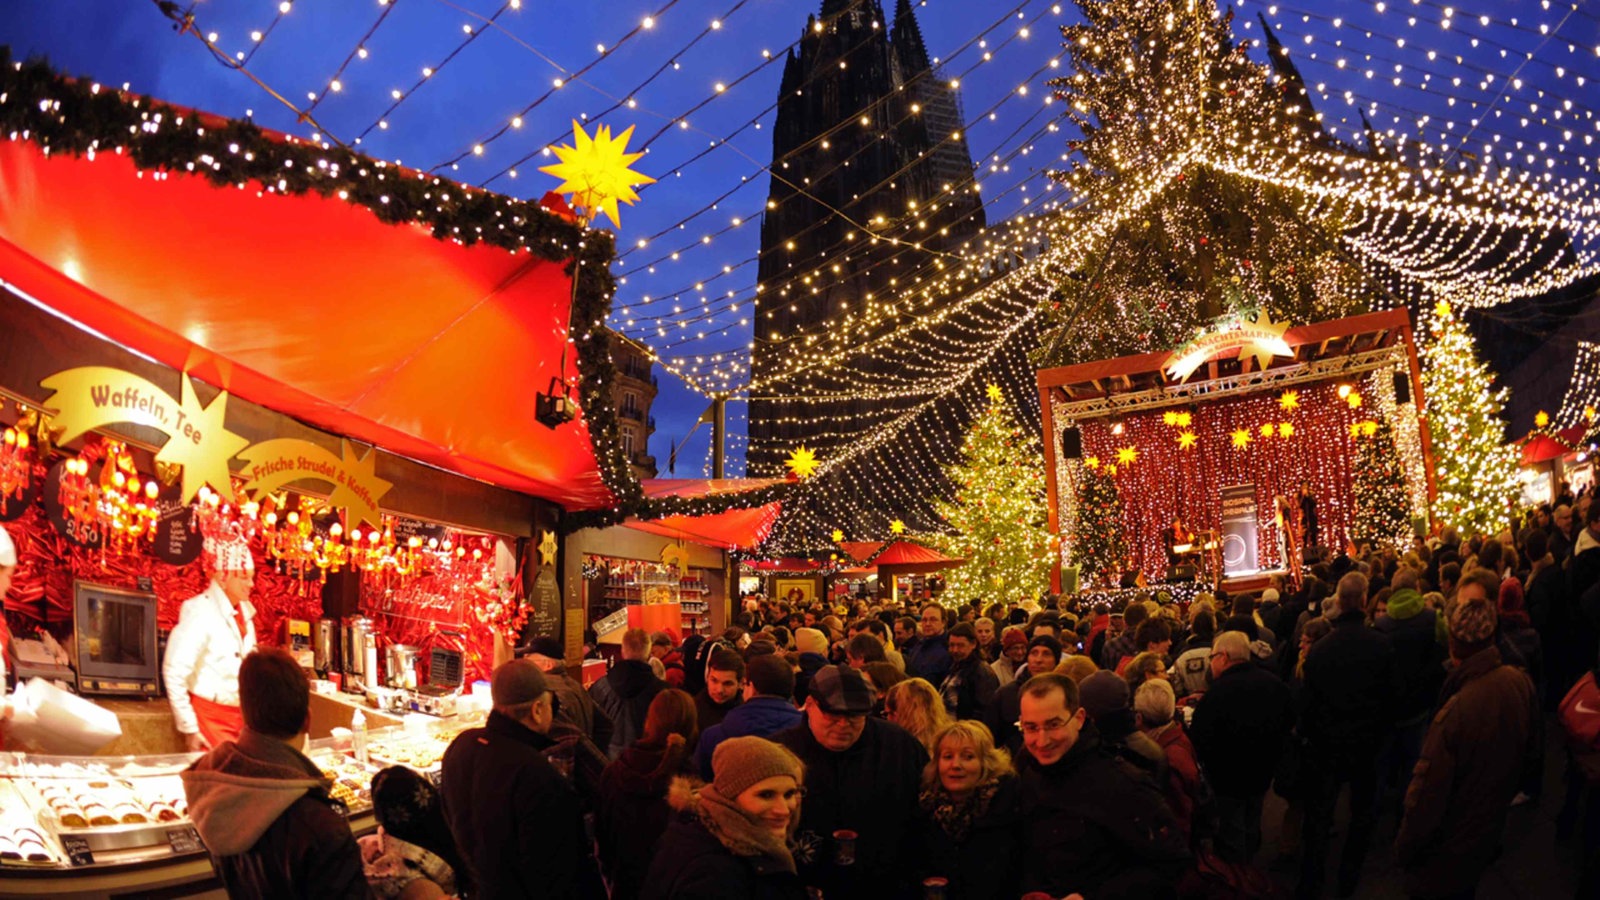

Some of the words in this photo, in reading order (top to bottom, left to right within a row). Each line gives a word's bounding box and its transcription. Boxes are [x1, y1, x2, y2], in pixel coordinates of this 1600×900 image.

[90, 385, 168, 424] Waffeln,
[176, 410, 202, 445] Tee
[252, 456, 295, 481] Frische
[297, 456, 337, 479] Strudel
[337, 470, 346, 484] &
[347, 475, 377, 512] Kaffee
